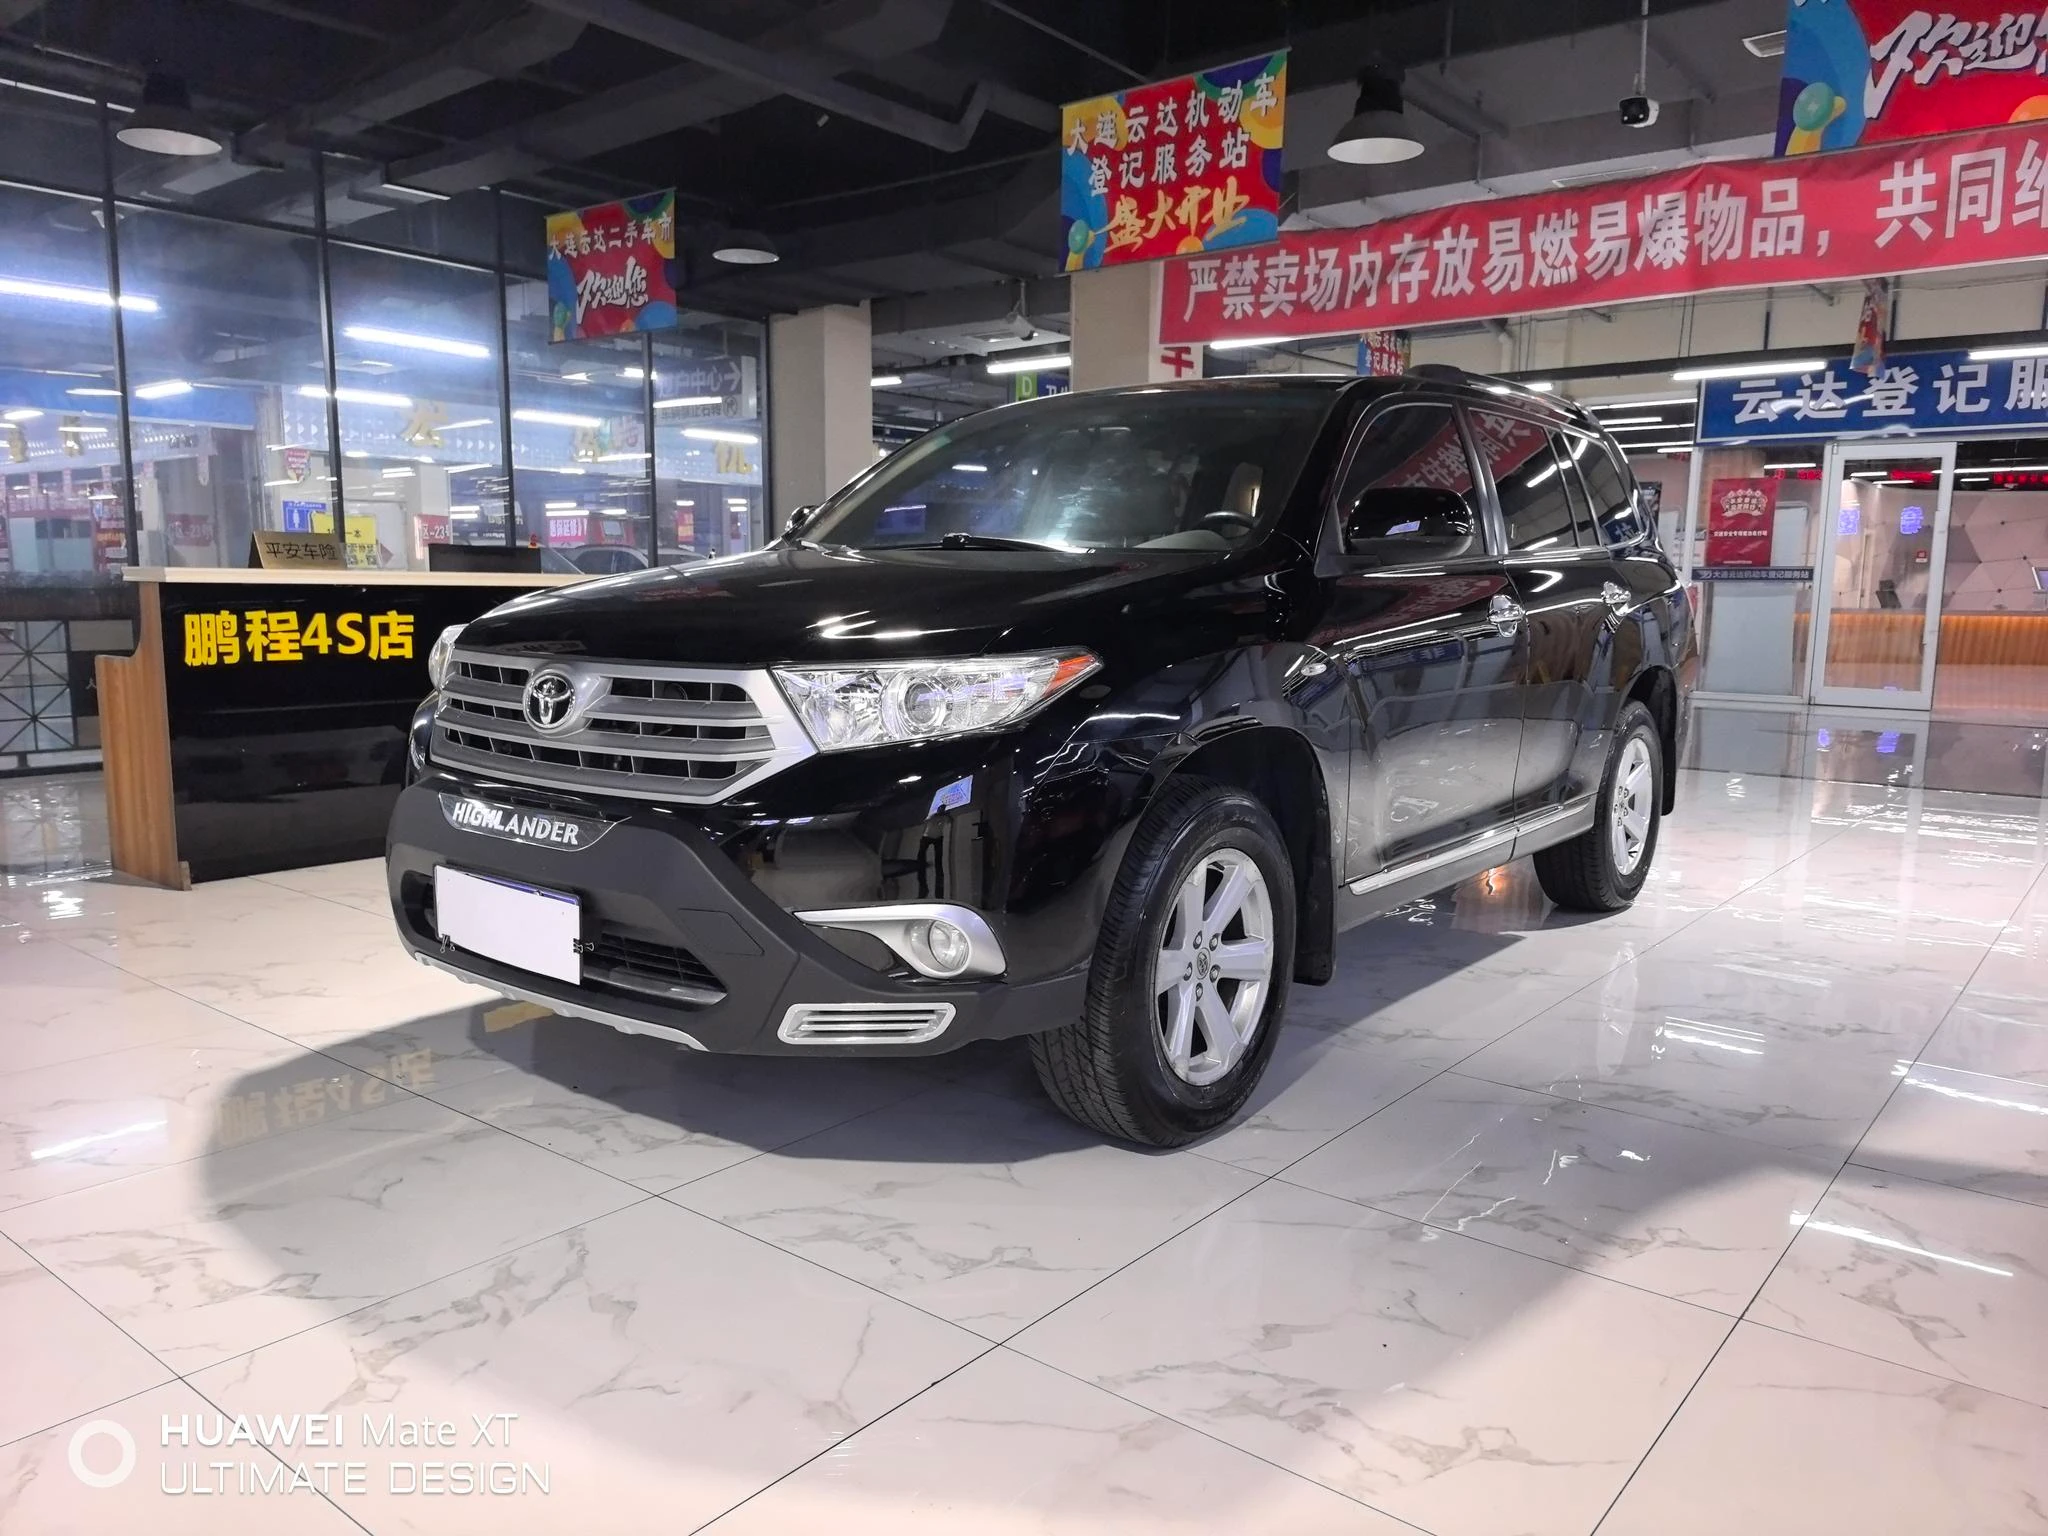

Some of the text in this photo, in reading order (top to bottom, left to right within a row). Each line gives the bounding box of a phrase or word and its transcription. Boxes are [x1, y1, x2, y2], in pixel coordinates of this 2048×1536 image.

[1863, 10, 2048, 119] 欢迎
[1067, 72, 1278, 156] 大连云达机动车
[1088, 127, 1250, 198] 登记服务站
[549, 211, 672, 260] 大连云达二手车市
[1096, 175, 1250, 253] 盛大开业
[1183, 177, 1830, 323] 严禁卖场内存放易燃易爆物品，
[576, 255, 649, 324] 欢迎您
[1732, 358, 2048, 424] 云达登记服
[264, 542, 338, 560] 平安车险
[184, 610, 414, 667] 鹏程4S店
[452, 801, 579, 845] HIGHLANDER
